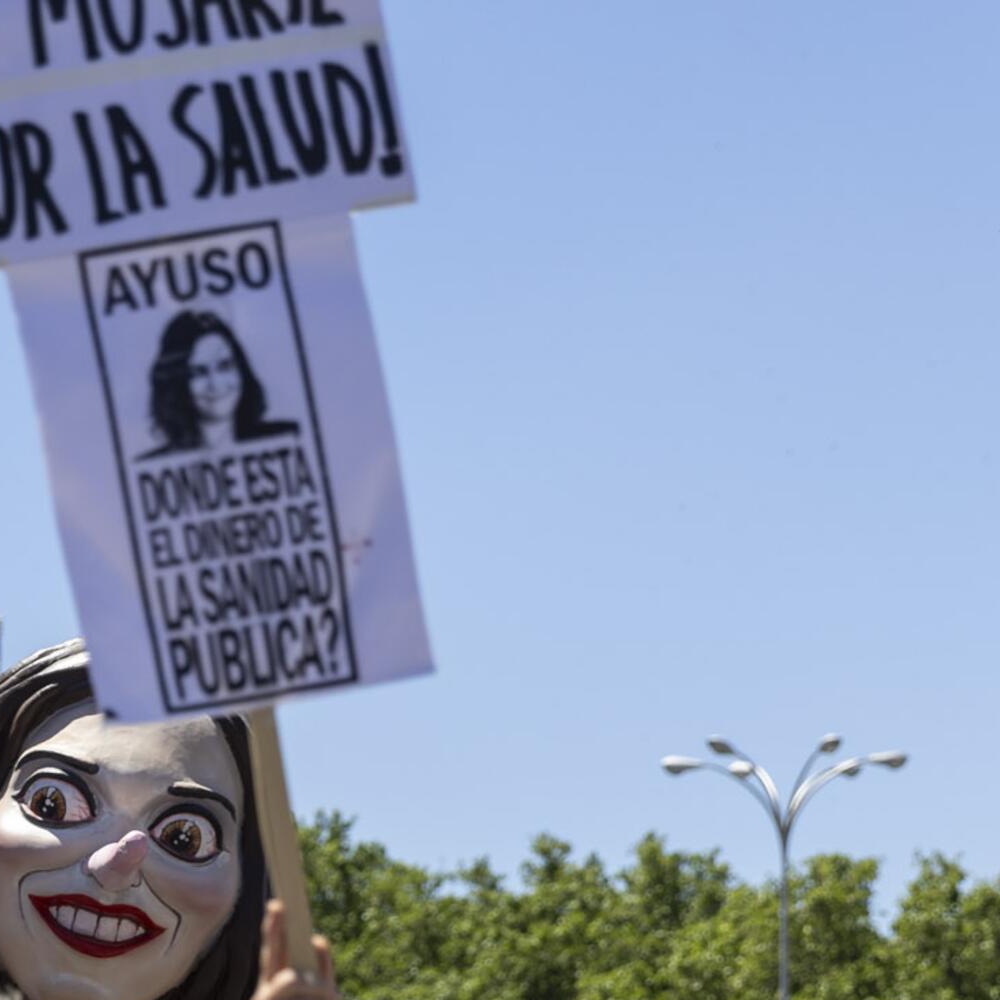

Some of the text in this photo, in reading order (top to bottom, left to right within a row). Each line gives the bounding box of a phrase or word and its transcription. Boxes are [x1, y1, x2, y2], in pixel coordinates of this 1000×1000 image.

[27, 0, 346, 68] MOJA
[74, 103, 168, 226] LA
[172, 42, 404, 199] SALUD!
[103, 241, 272, 316] AYUSO
[138, 446, 316, 522] DONDE ESTA
[151, 501, 326, 569] EL DINERO DE
[157, 550, 333, 631] LA SANIDAD
[168, 607, 340, 700] PUBLICA?
